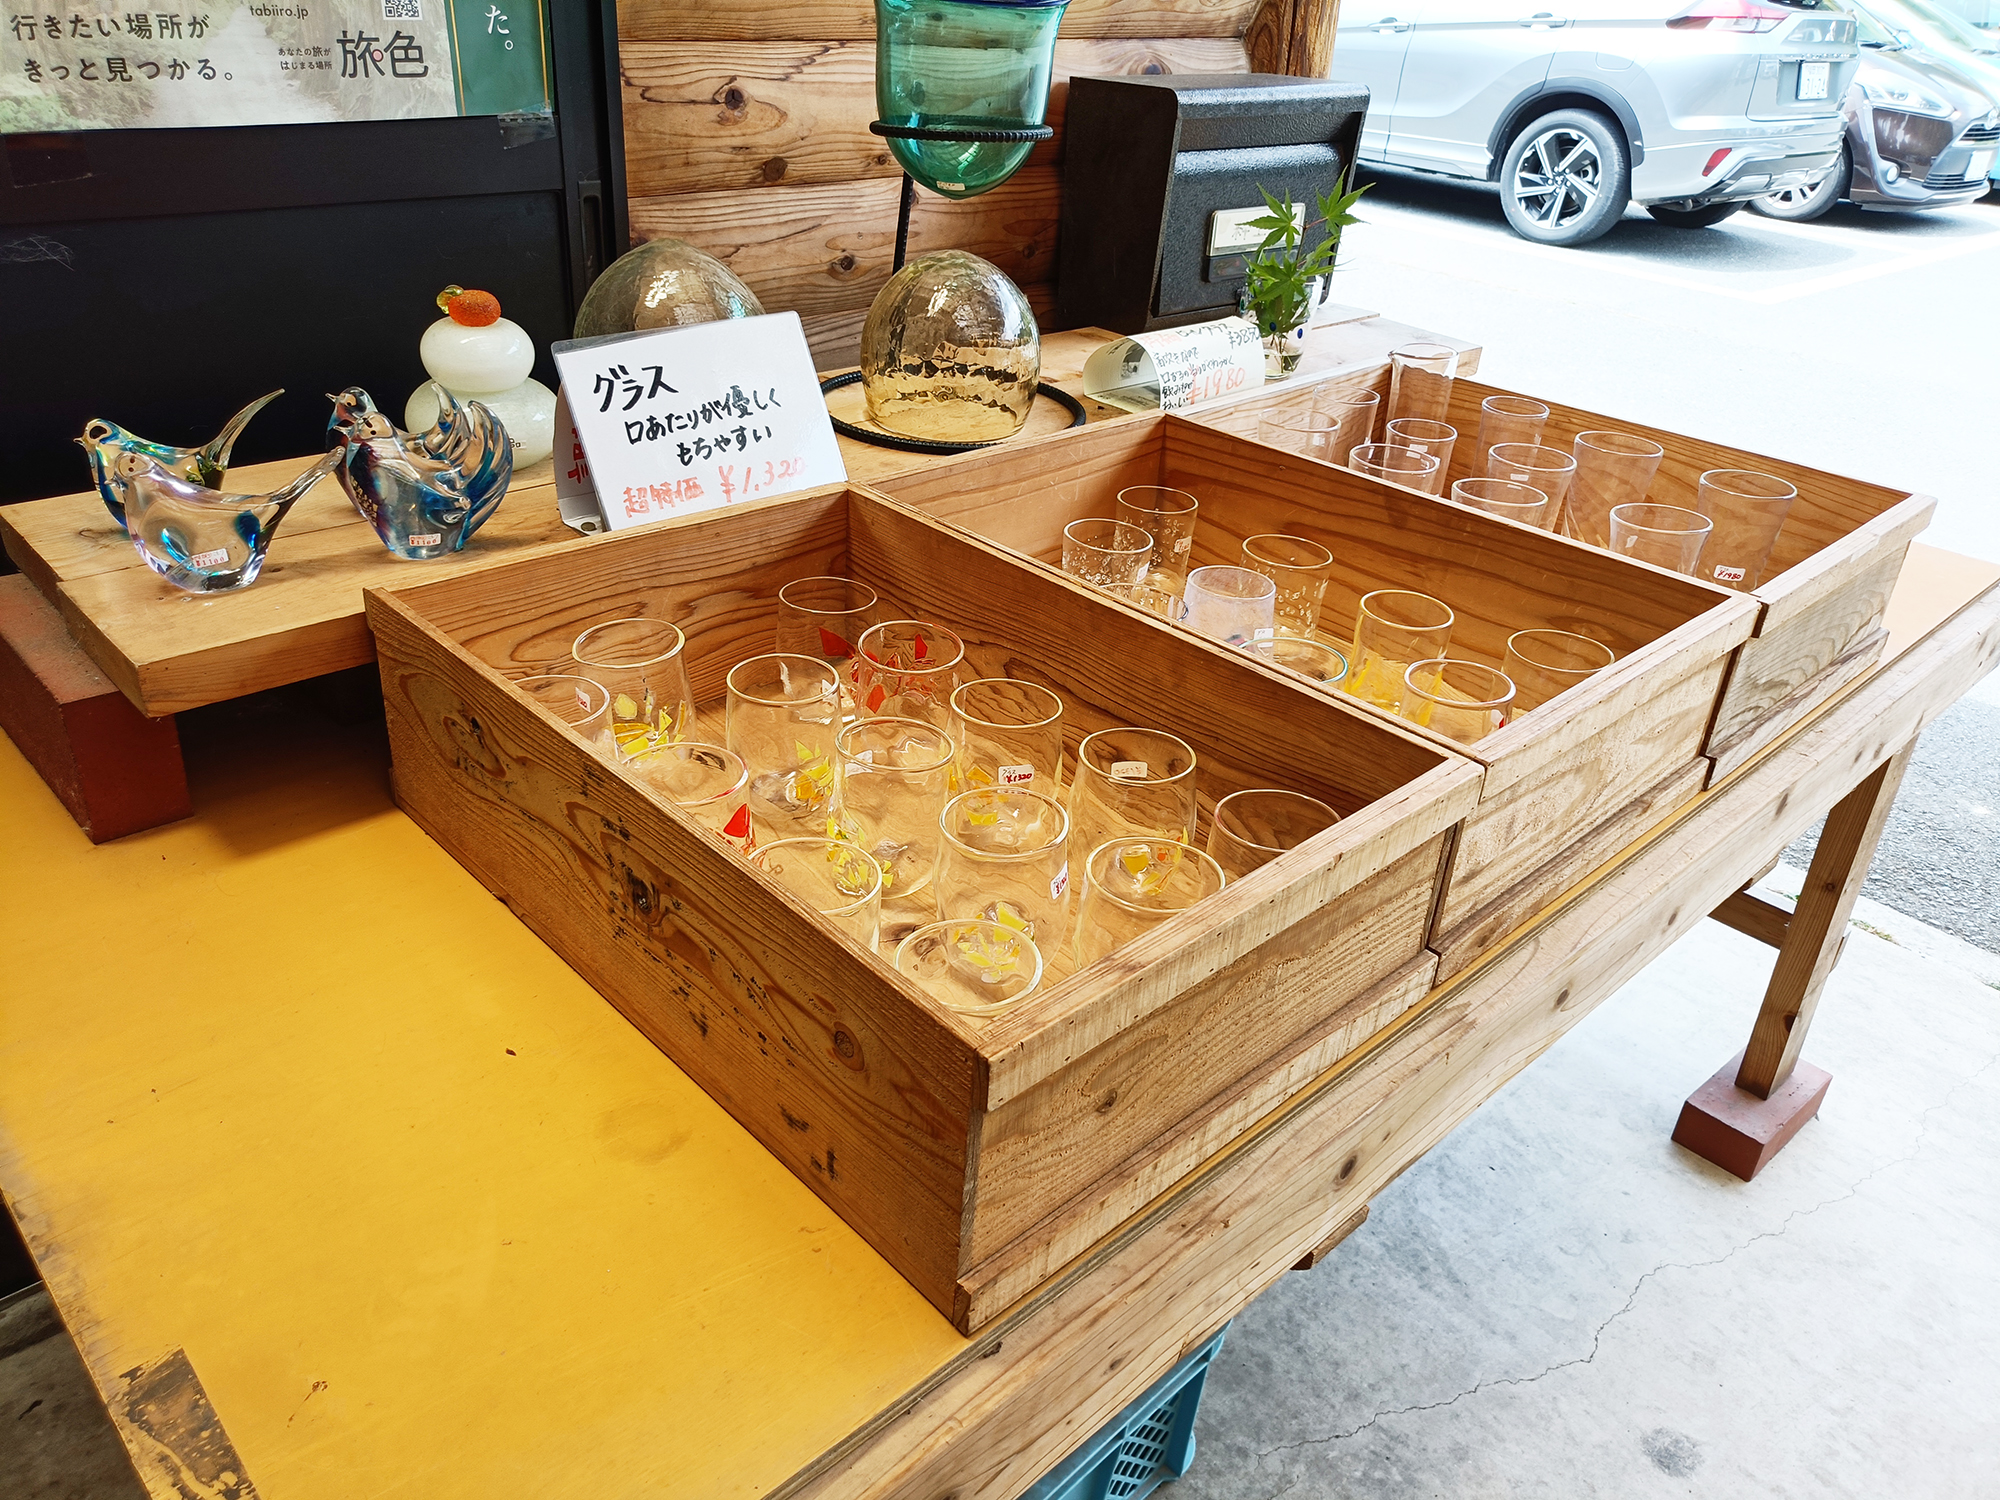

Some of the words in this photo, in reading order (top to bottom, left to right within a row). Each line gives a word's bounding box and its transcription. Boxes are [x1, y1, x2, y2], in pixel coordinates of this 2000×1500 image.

[250, 4, 309, 20] tabiiro.jp
[10, 13, 210, 41] 行きたい場所が
[278, 45, 332, 58] あなたの旅が
[336, 30, 429, 79] 旅色
[23, 57, 234, 83] きっと見つかる。
[280, 60, 333, 71] はじまる場所
[593, 364, 679, 412] グラス
[1185, 367, 1246, 405] ¥1980
[624, 384, 782, 445] 口あたりが優しく
[676, 425, 773, 466] もちやすい
[1717, 570, 1742, 579] ¥1980
[1006, 773, 1033, 784] ¥1320
